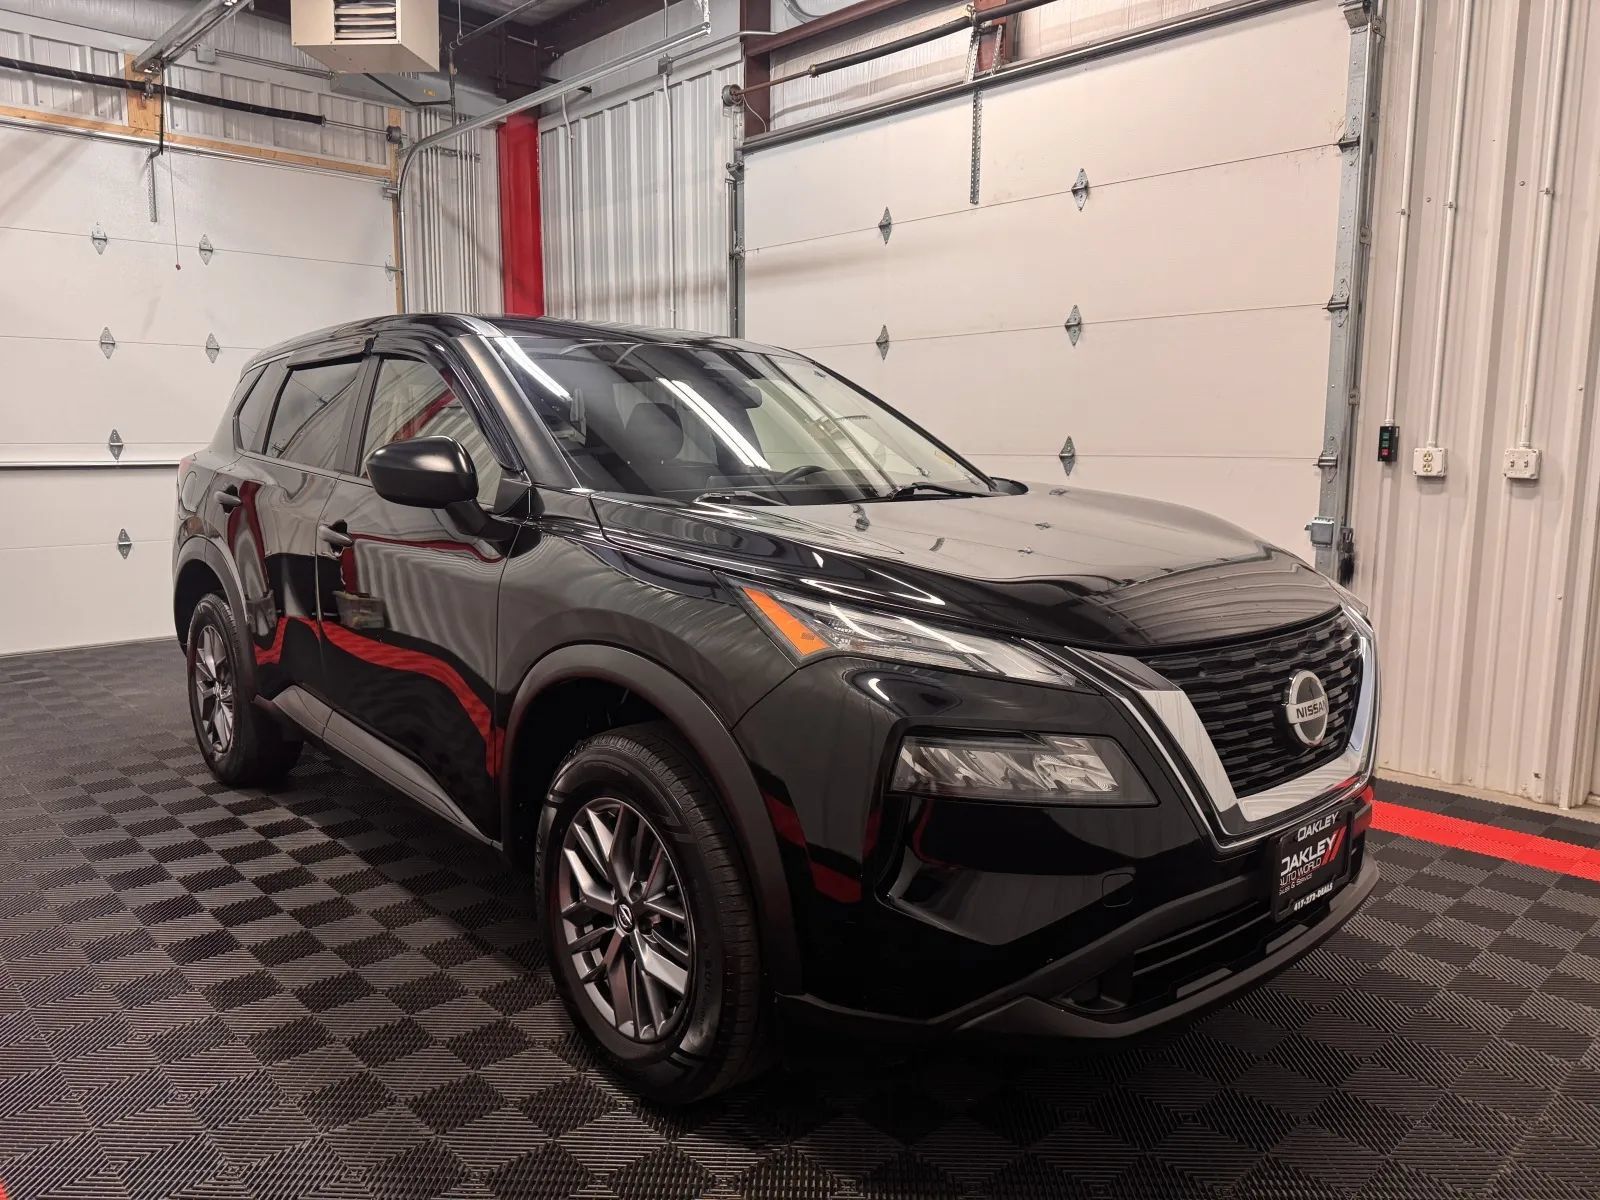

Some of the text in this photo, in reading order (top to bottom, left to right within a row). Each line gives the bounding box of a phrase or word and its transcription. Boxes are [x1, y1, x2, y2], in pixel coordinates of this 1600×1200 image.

[1296, 700, 1328, 719] NISSAN
[1297, 811, 1339, 842] OAKLEY
[1279, 857, 1322, 887] AUTO WORLD
[1290, 881, 1296, 889] &
